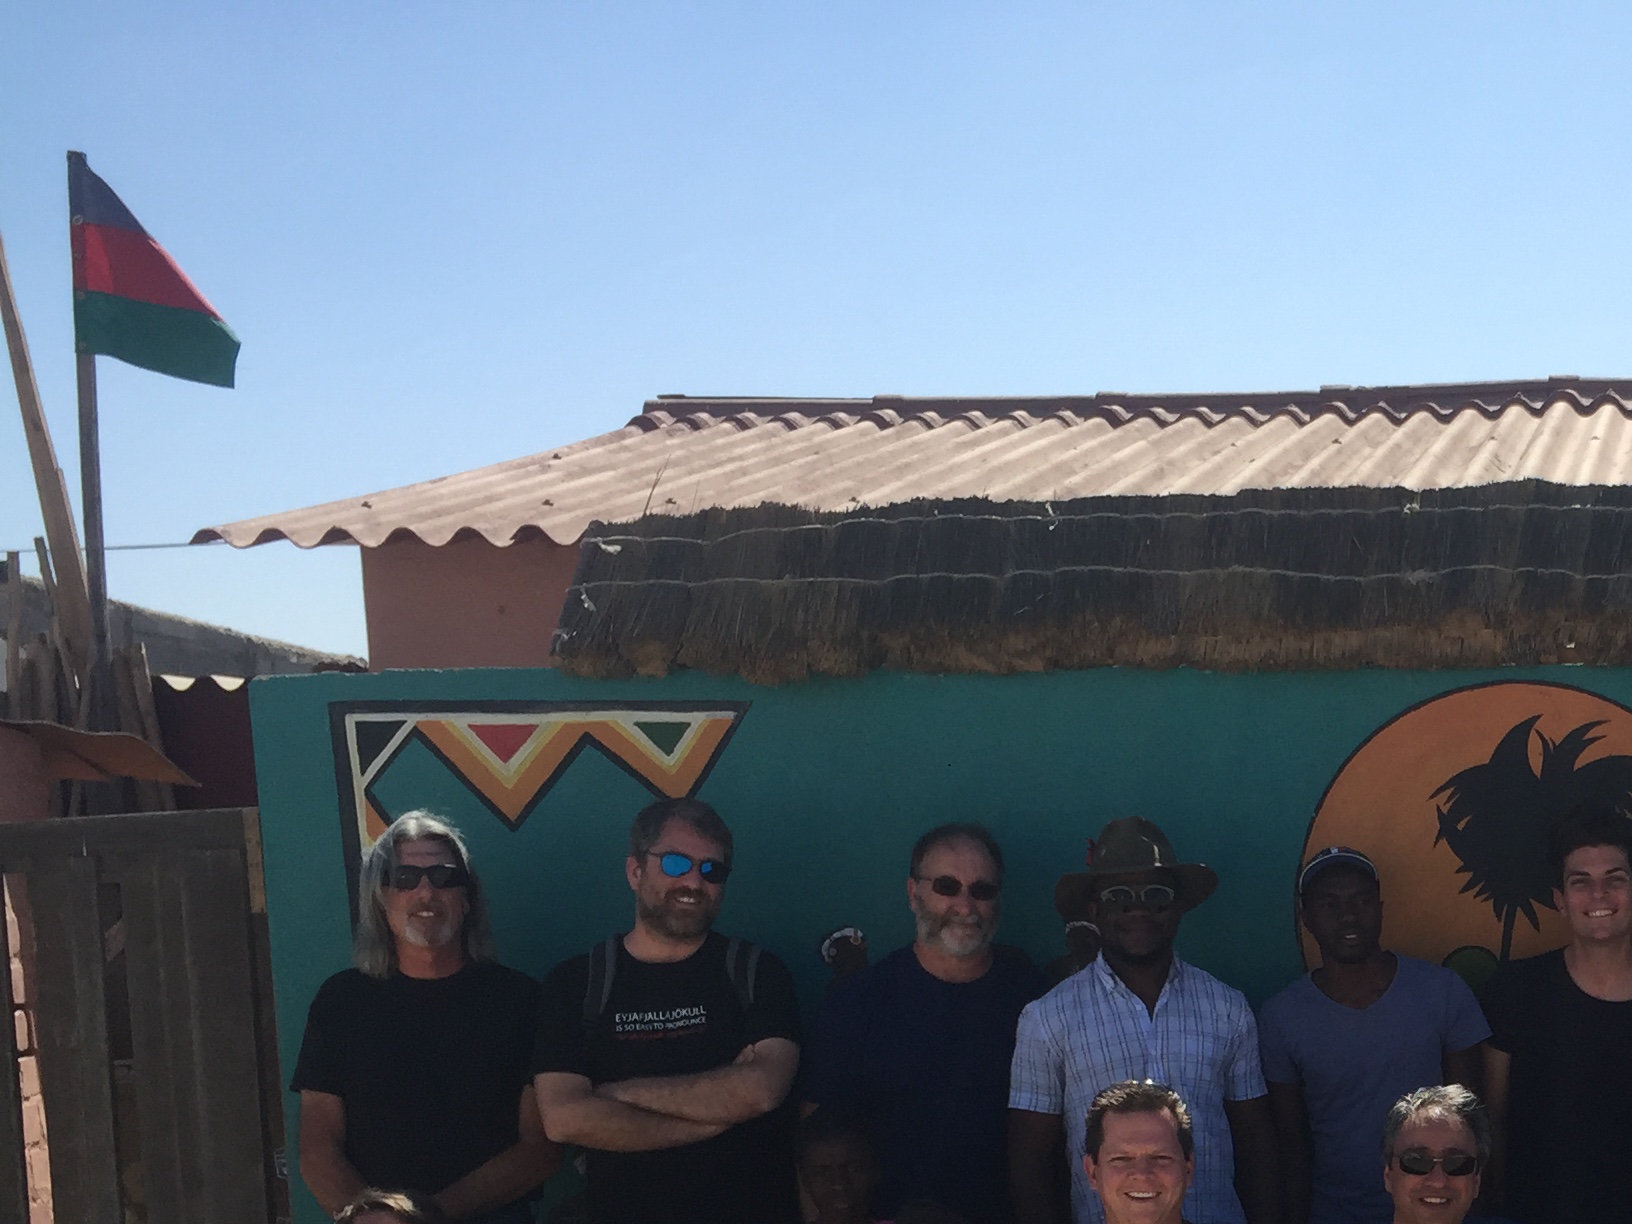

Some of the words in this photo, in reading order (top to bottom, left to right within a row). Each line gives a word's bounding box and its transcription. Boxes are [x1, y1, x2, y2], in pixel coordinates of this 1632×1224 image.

[616, 1024, 623, 1032] IS
[624, 1023, 635, 1031] SO
[653, 1022, 665, 1030] TO
